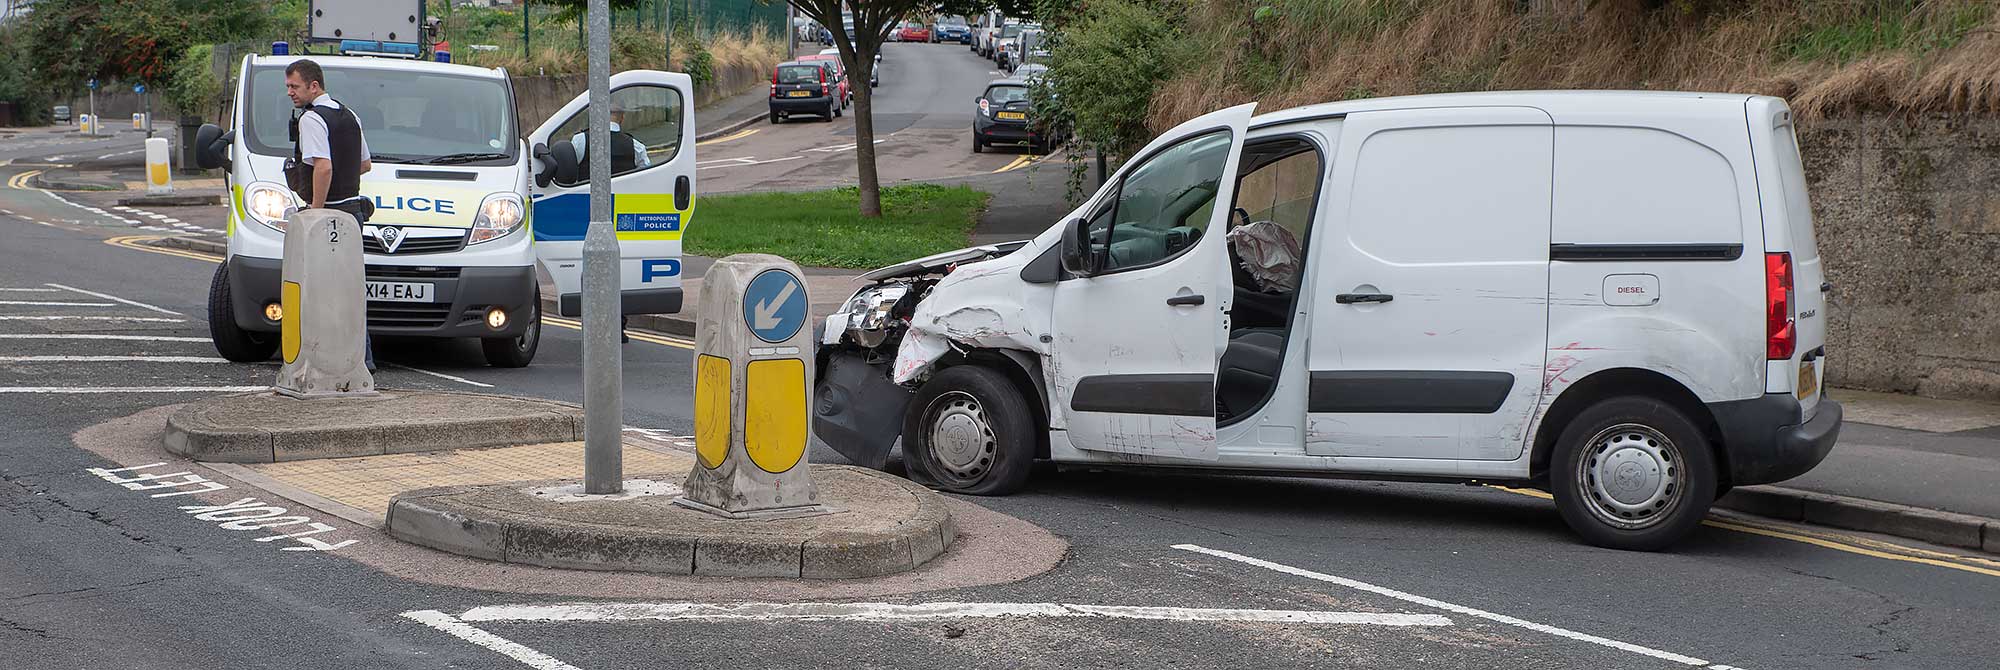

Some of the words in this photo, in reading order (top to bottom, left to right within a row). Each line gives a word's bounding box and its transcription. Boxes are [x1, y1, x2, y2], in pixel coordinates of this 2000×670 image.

[375, 196, 456, 215] LICE
[330, 219, 338, 230] 1
[330, 232, 339, 243] 2
[642, 259, 681, 283] P
[365, 284, 389, 299] X14
[393, 285, 425, 299] EAJ
[1617, 286, 1645, 294] DIESEL
[86, 462, 229, 498] LEFT
[177, 497, 337, 542] LOOK
